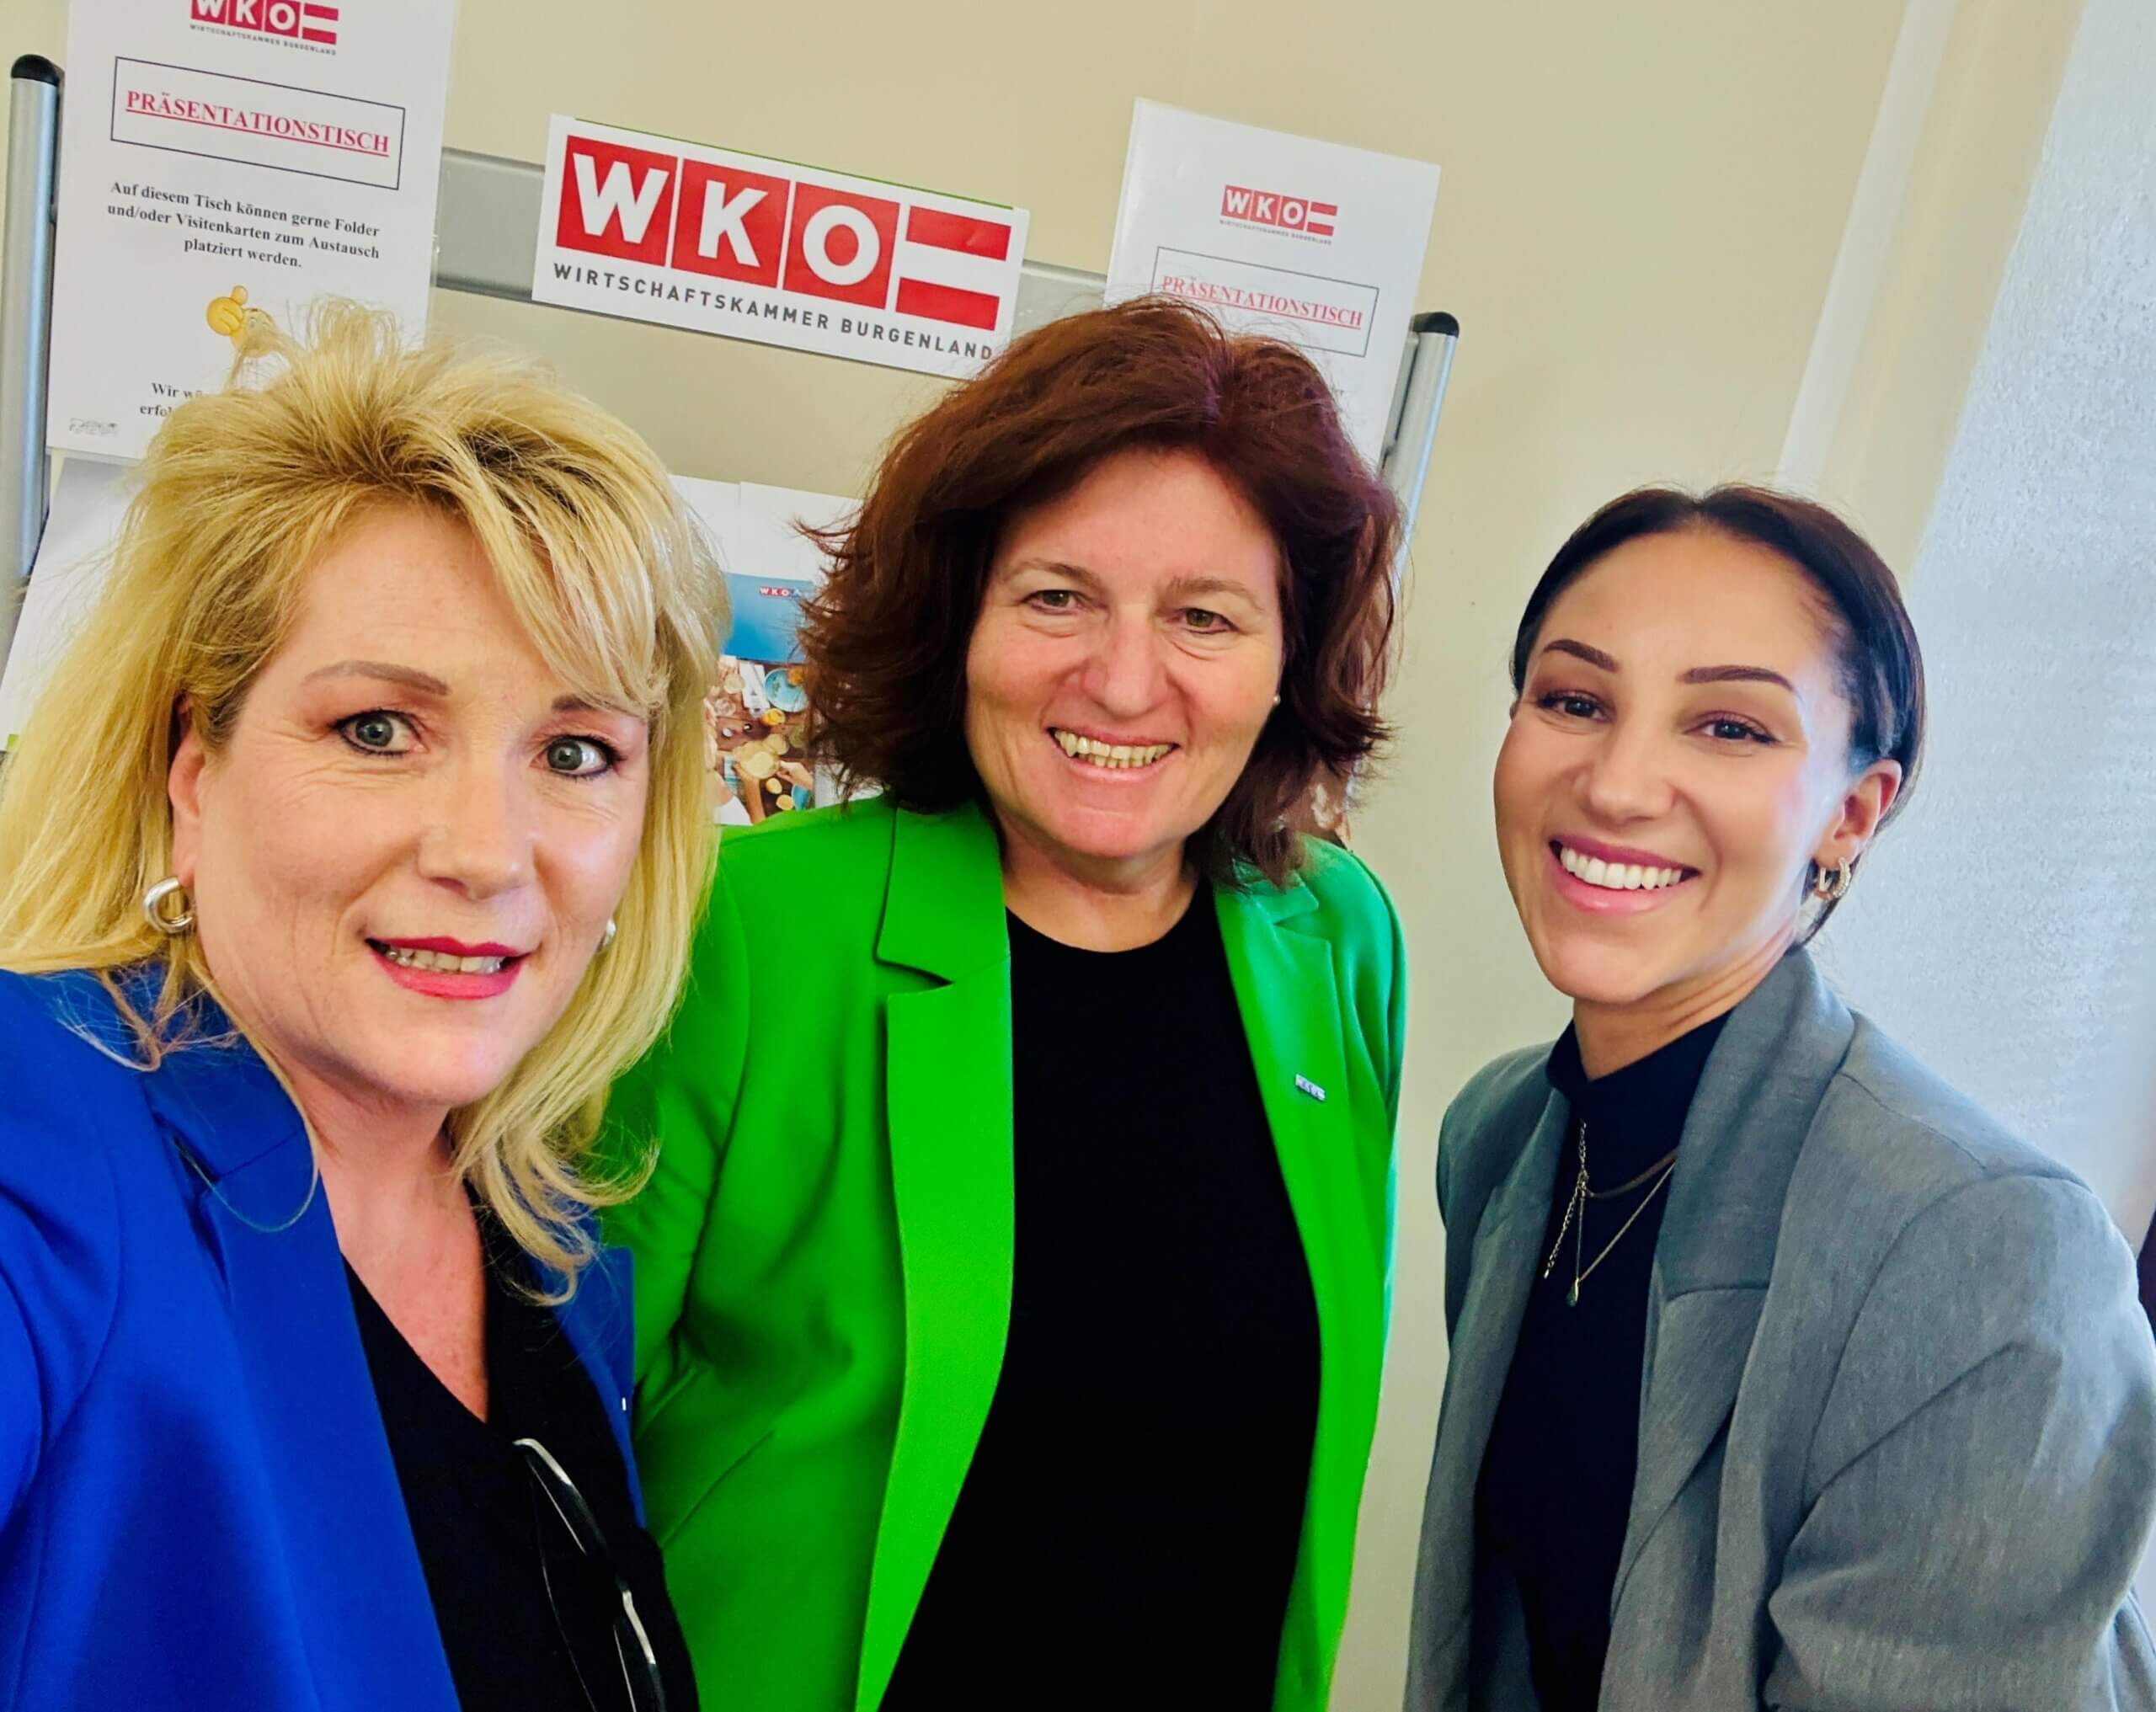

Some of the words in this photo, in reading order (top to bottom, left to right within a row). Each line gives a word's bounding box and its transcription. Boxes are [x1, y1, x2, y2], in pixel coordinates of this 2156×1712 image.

[196, 0, 296, 30] WKO
[125, 90, 389, 157] PRÄSENTATIONSTISCH
[108, 205, 172, 224] und/oder
[176, 212, 270, 241] Visitenkarten
[274, 232, 304, 246] zum
[308, 236, 380, 259] Austausch
[110, 181, 139, 196] Auf
[141, 185, 189, 205] diesem
[194, 194, 232, 212] Tisch
[236, 201, 287, 221] können
[291, 213, 330, 229] gerne
[334, 217, 381, 237] Folder
[573, 152, 881, 286] WKO
[1225, 189, 1304, 225] WKO
[184, 238, 243, 259] platziert
[247, 248, 302, 268] werden.
[553, 262, 830, 330] WIRTSCHAFTSKAMMER
[841, 317, 993, 360] BURGENLAND
[1162, 275, 1363, 329] PRÄSENTATIONSTISCH
[151, 381, 179, 398] Wir
